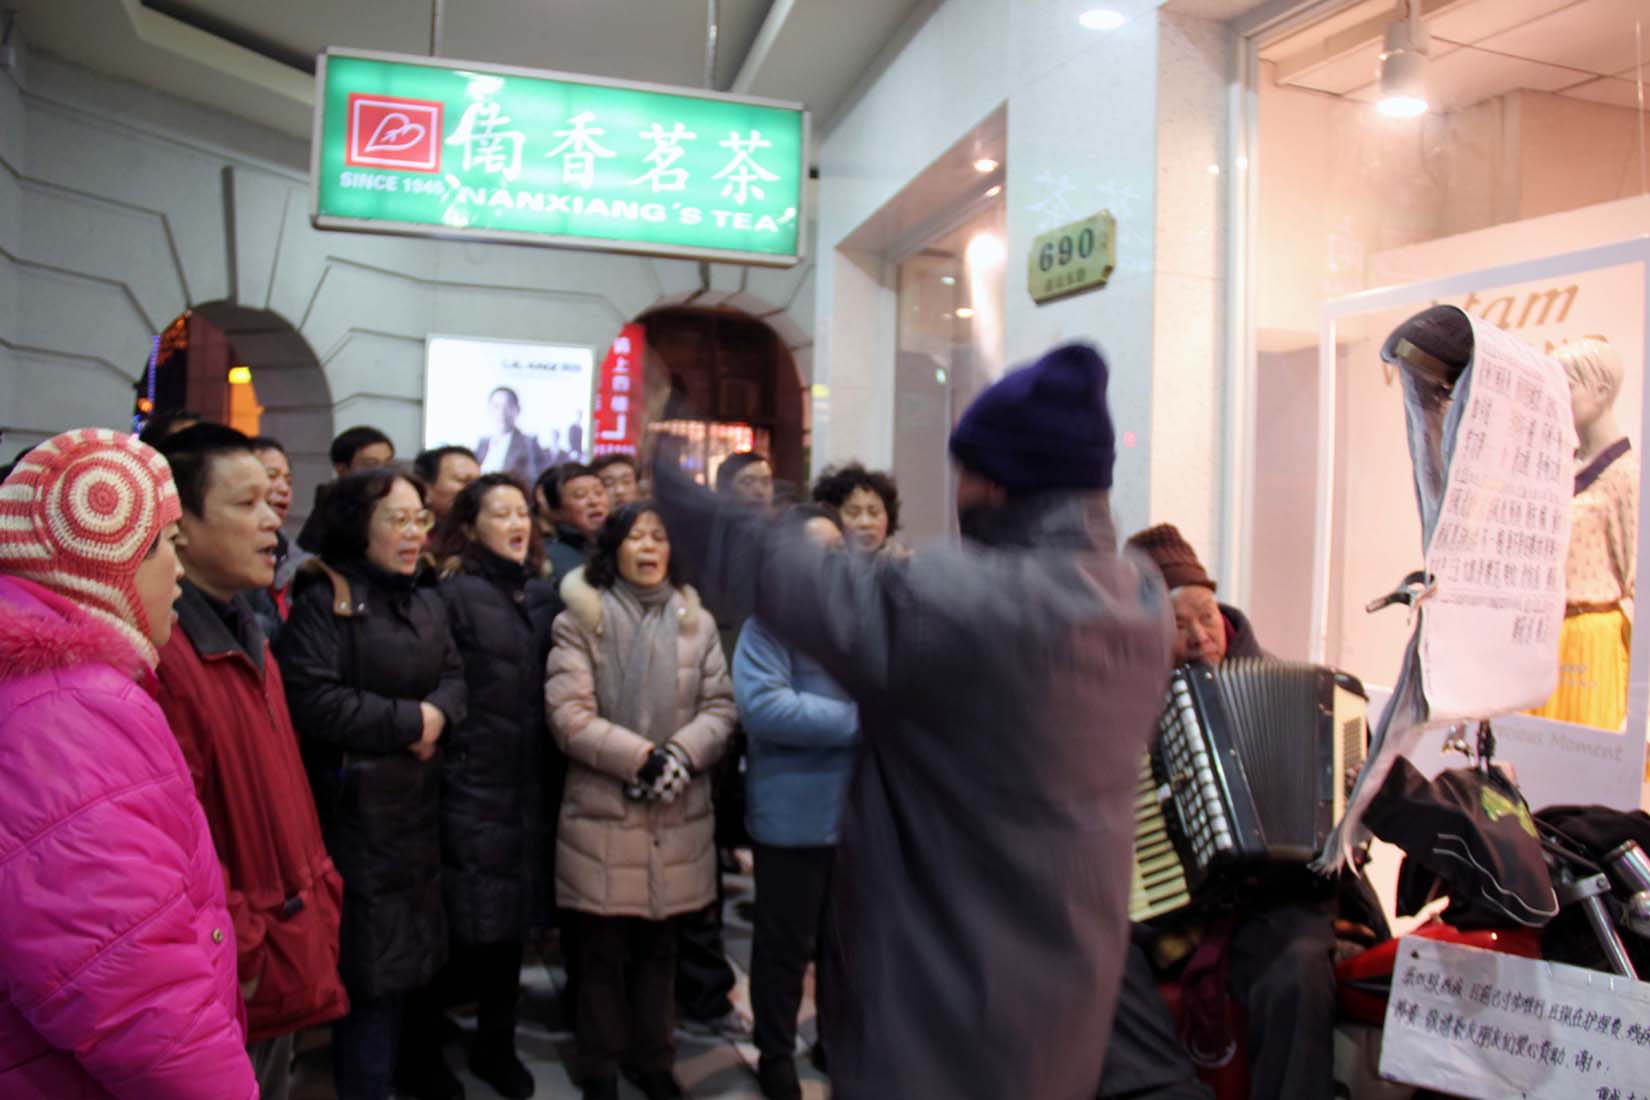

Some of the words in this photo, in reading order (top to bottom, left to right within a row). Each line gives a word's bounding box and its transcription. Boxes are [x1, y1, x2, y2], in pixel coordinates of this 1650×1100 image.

[340, 171, 398, 192] SINCE
[456, 184, 702, 225] NANXIANG'S
[710, 209, 779, 233] TEA
[1039, 228, 1095, 272] 690
